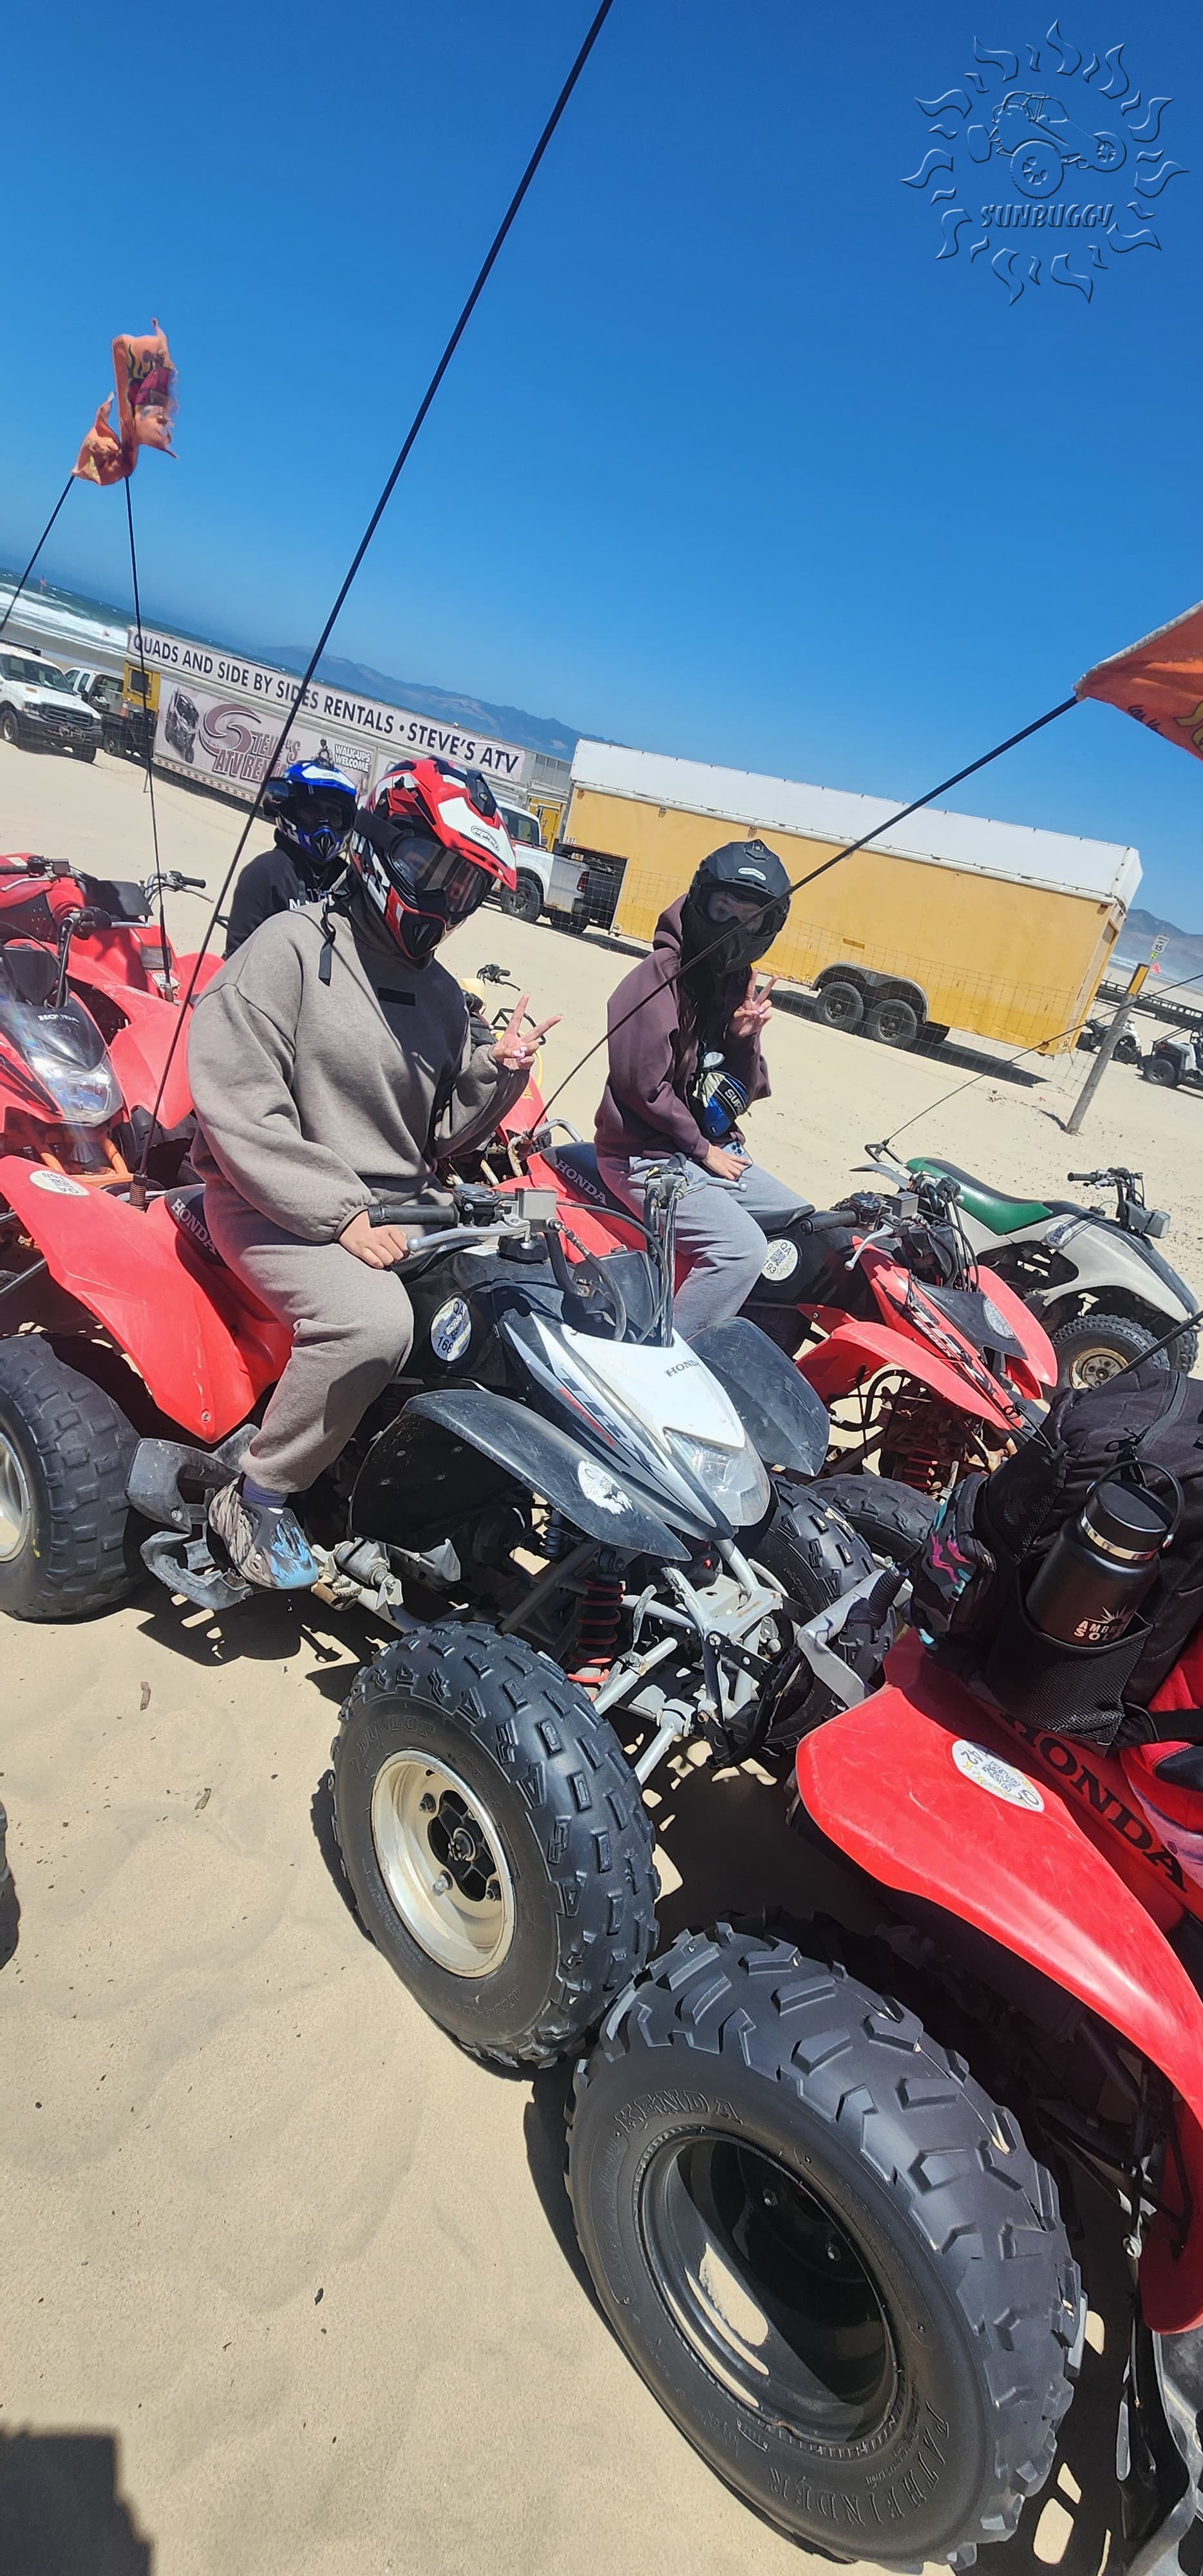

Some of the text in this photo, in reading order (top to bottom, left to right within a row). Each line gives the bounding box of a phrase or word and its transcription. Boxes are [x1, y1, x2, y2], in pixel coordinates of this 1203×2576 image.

[133, 634, 520, 773] QUADS AND SIDE BY SIDES RENTALS STEVE'S ATV
[213, 750, 244, 777] ATV
[334, 753, 370, 773] WELCOME
[554, 1159, 607, 1206] HONDA
[171, 1197, 217, 1256] HONDA
[763, 1258, 777, 1274] 193
[780, 1242, 792, 1256] QA
[453, 1300, 464, 1320] QA
[437, 1336, 454, 1354] 168
[357, 1714, 436, 1757] DUNLOP
[613, 2089, 743, 2134] KENDA
[770, 2400, 949, 2526] PATHFINDER
